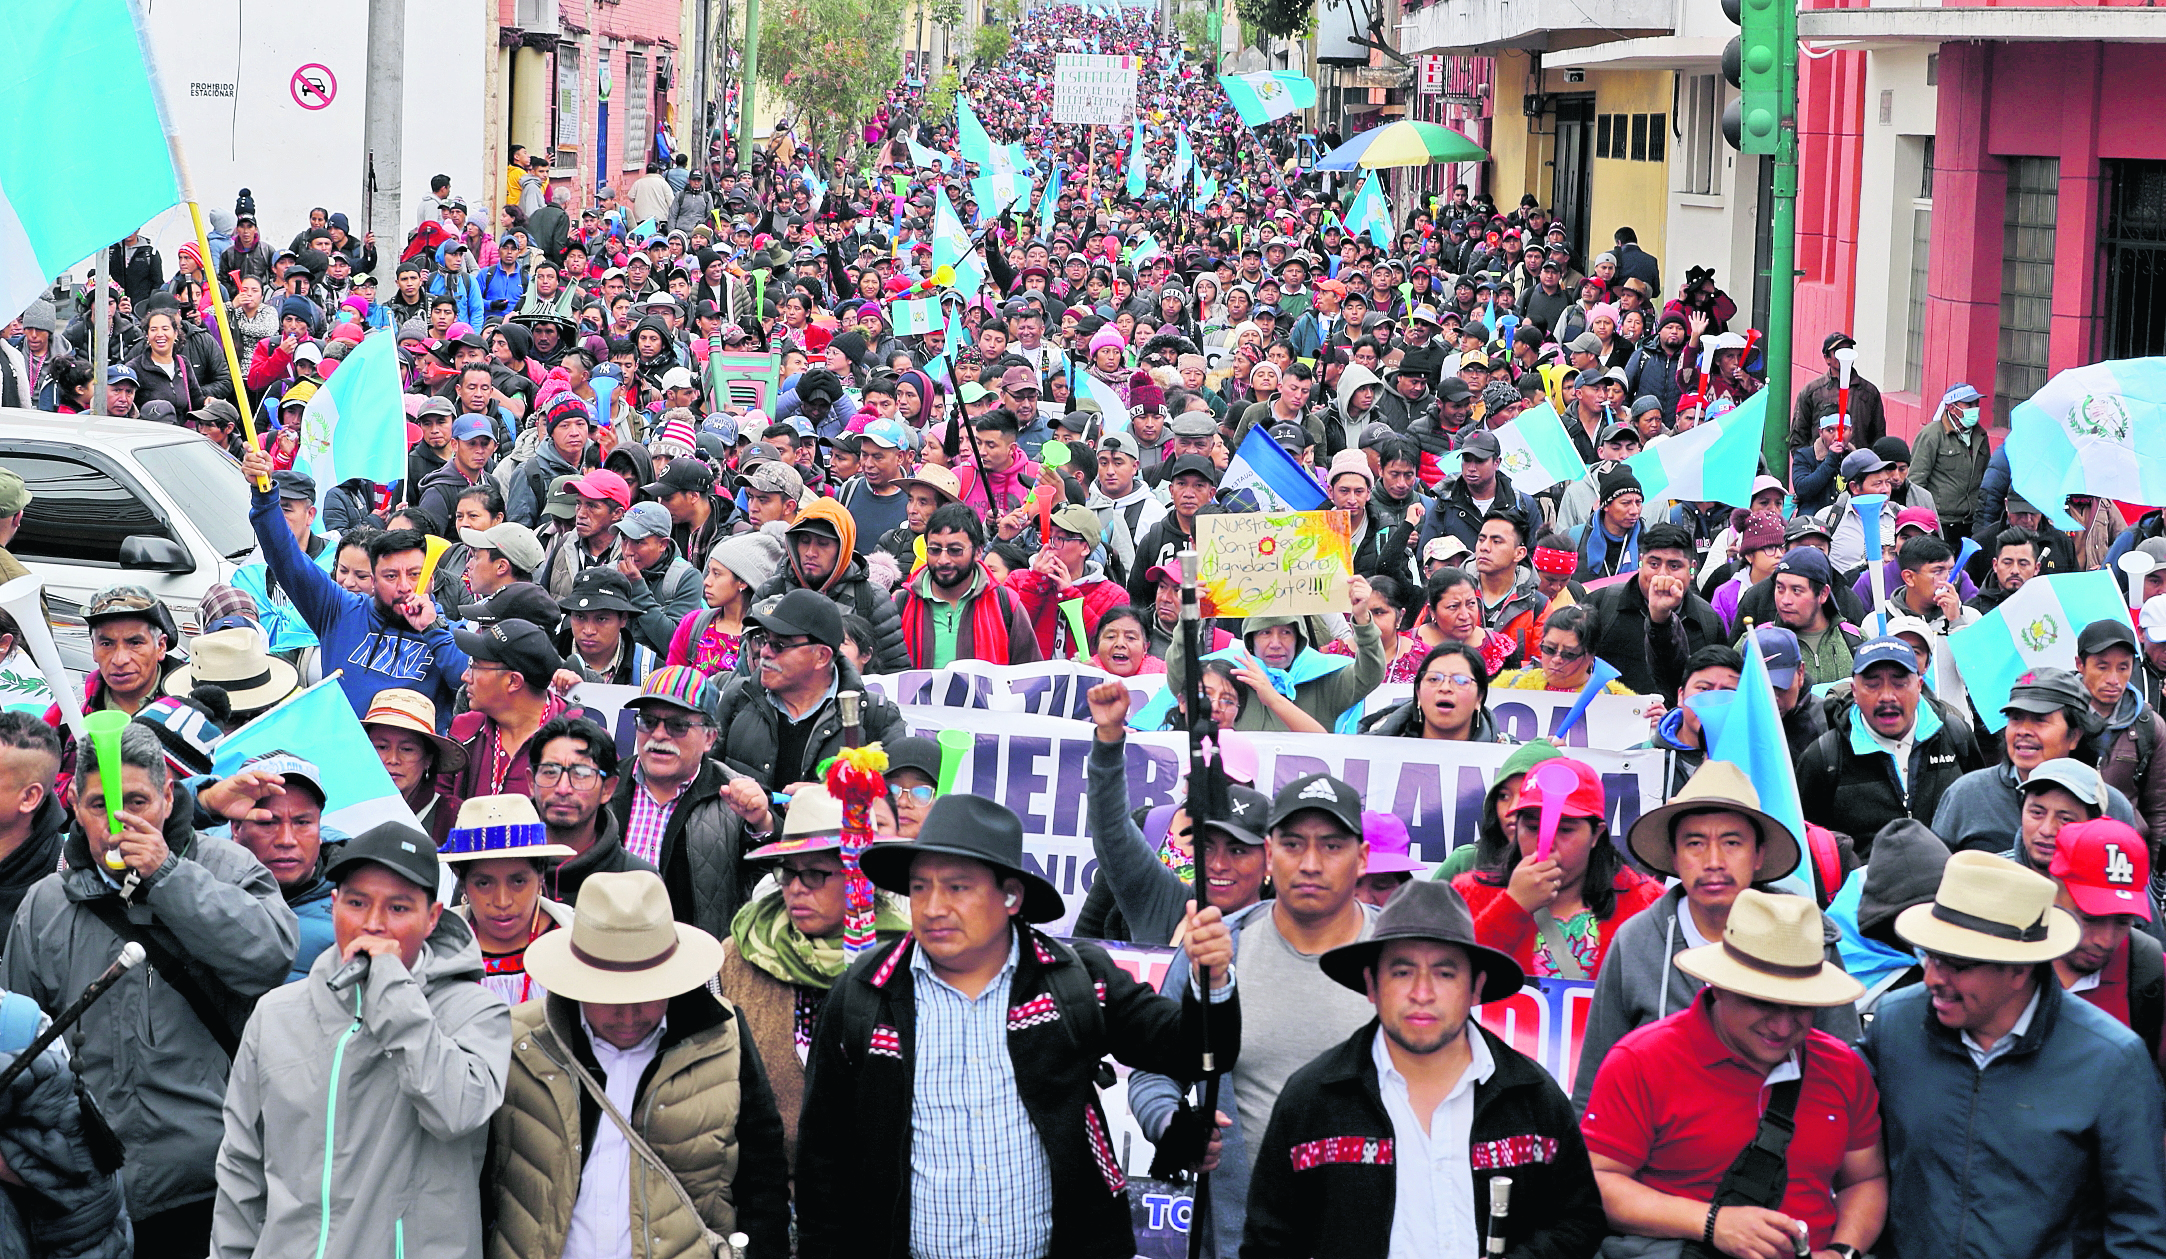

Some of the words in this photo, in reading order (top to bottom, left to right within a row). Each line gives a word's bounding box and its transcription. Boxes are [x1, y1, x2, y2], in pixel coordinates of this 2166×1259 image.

[1060, 71, 1134, 83] ESPERANZA
[190, 82, 234, 90] PROHIBIDO
[190, 89, 234, 97] ESTACIONAR
[1211, 516, 1283, 534] Nuestras
[1859, 640, 1910, 655] Champion
[347, 632, 434, 682] NIKE
[2105, 844, 2134, 884] LA
